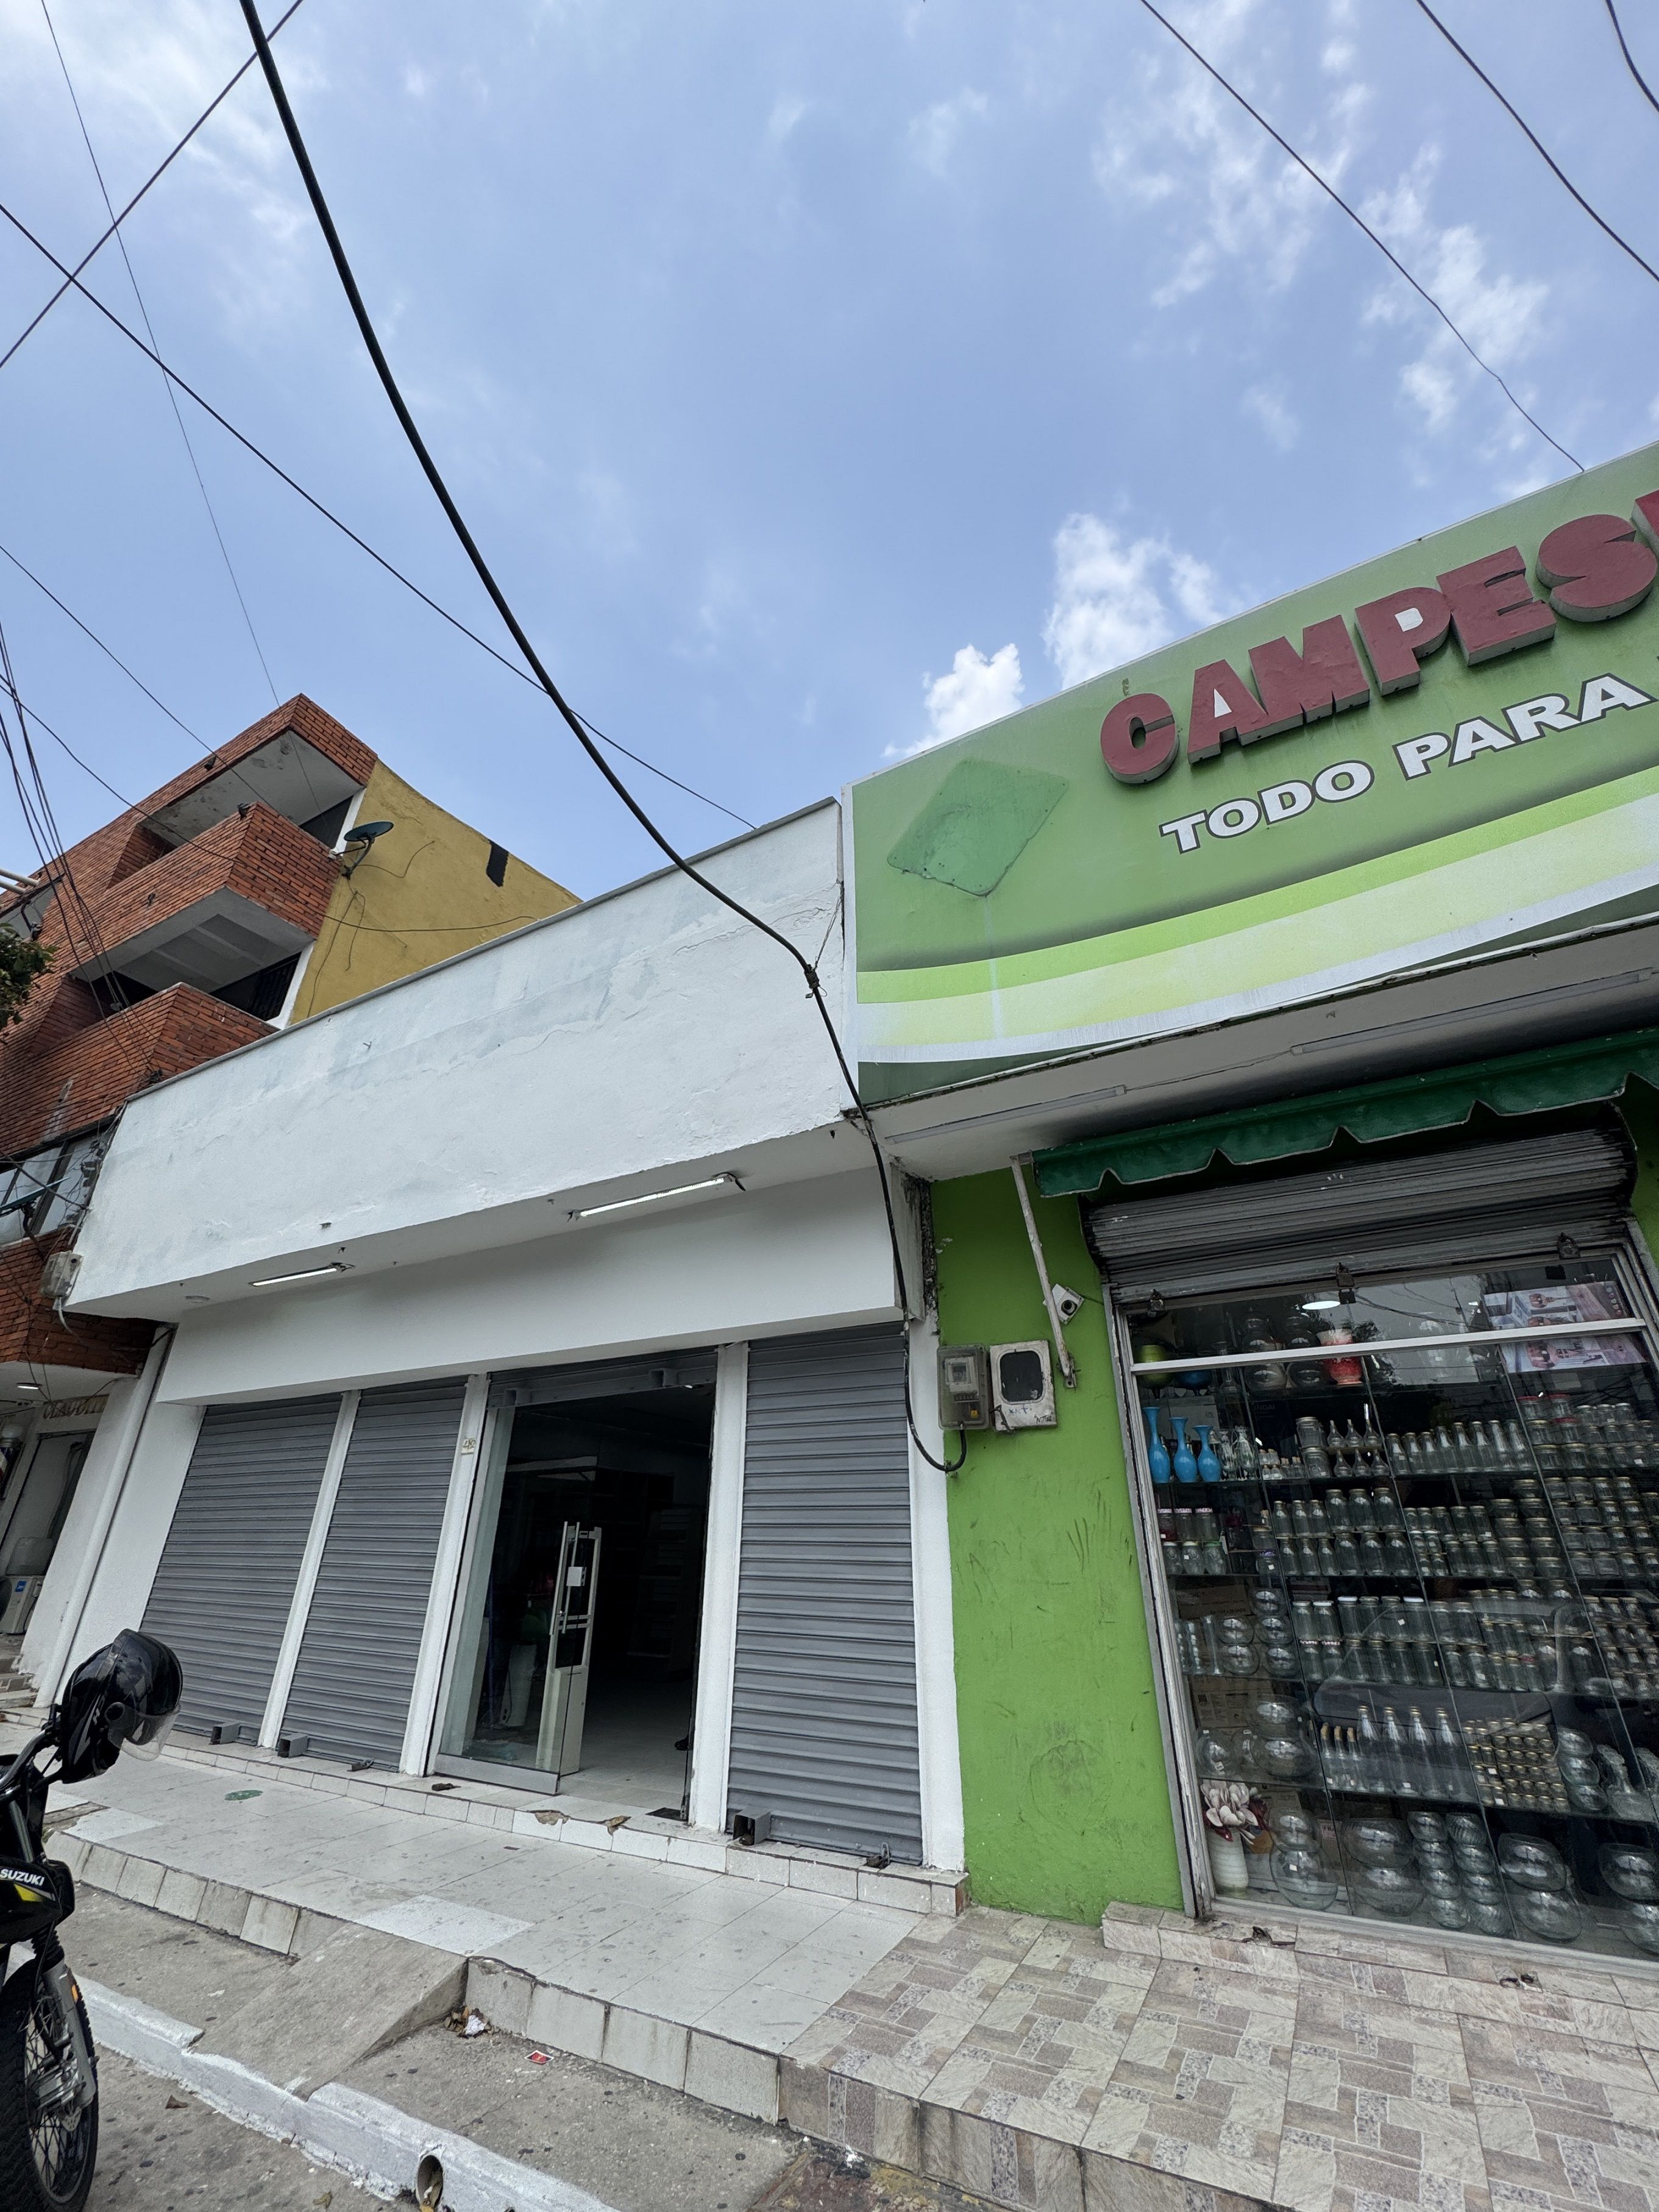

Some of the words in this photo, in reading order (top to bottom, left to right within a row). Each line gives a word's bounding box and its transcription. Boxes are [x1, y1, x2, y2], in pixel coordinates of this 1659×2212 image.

[1100, 489, 1659, 784] CAMPES
[1160, 759, 1374, 854] TODO
[1392, 672, 1658, 781] PARA
[0, 1868, 44, 1886] SUZUKI
